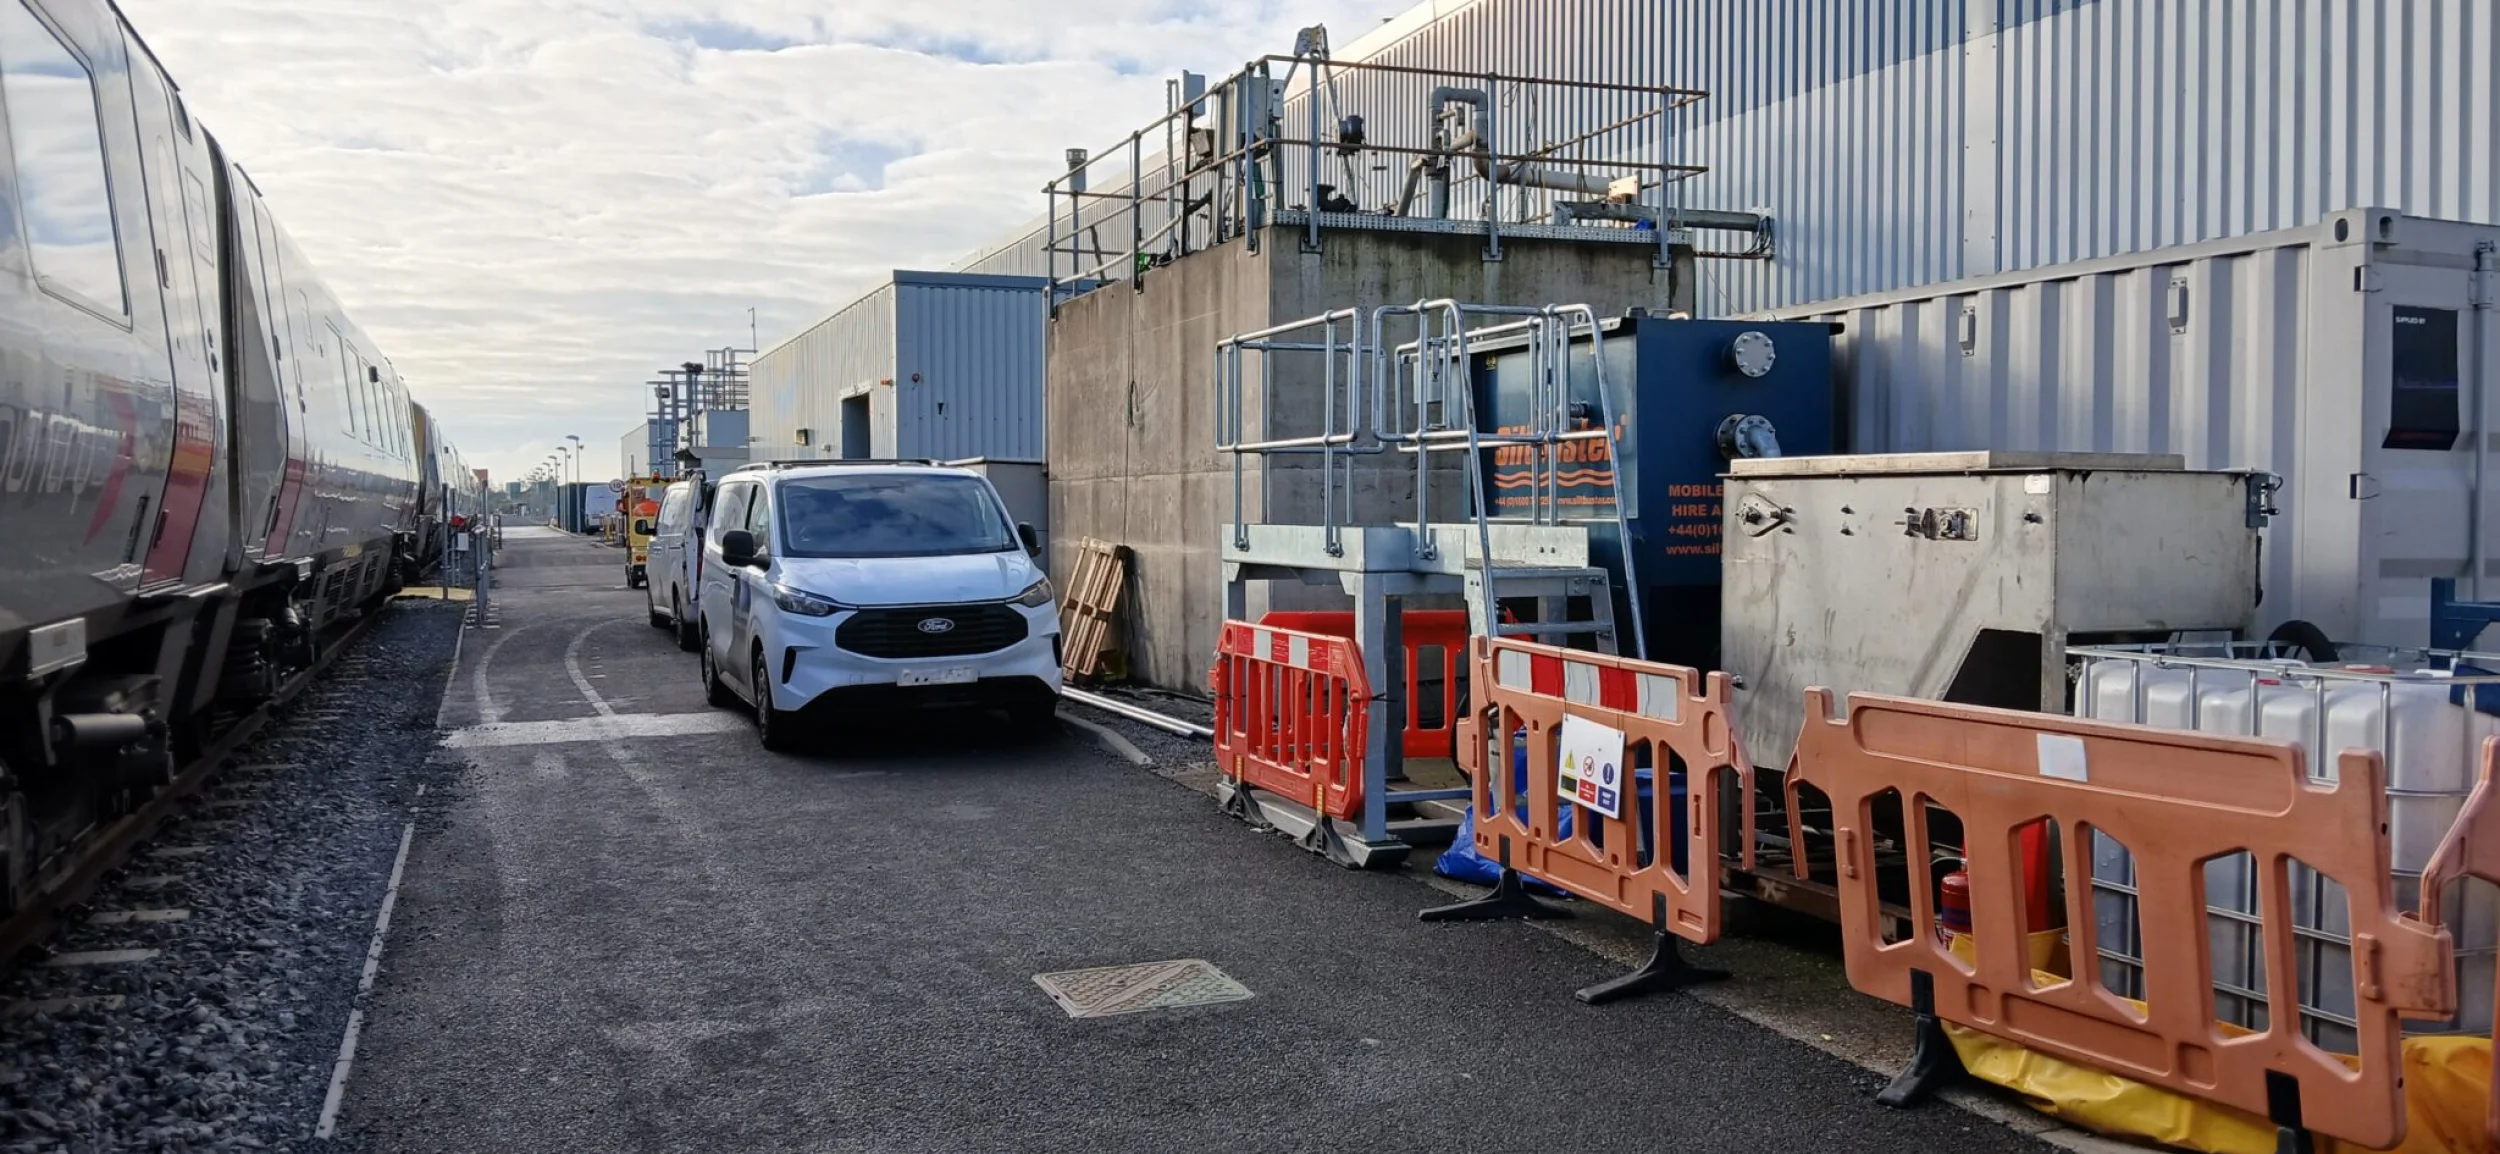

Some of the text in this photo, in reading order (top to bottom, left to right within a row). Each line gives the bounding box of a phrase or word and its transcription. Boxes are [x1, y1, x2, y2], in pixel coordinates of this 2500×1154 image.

[1668, 484, 1724, 497] MOBILE
[1671, 504, 1708, 516] HIRE
[1665, 542, 1722, 555] www.sil
[923, 620, 949, 631] Ford
